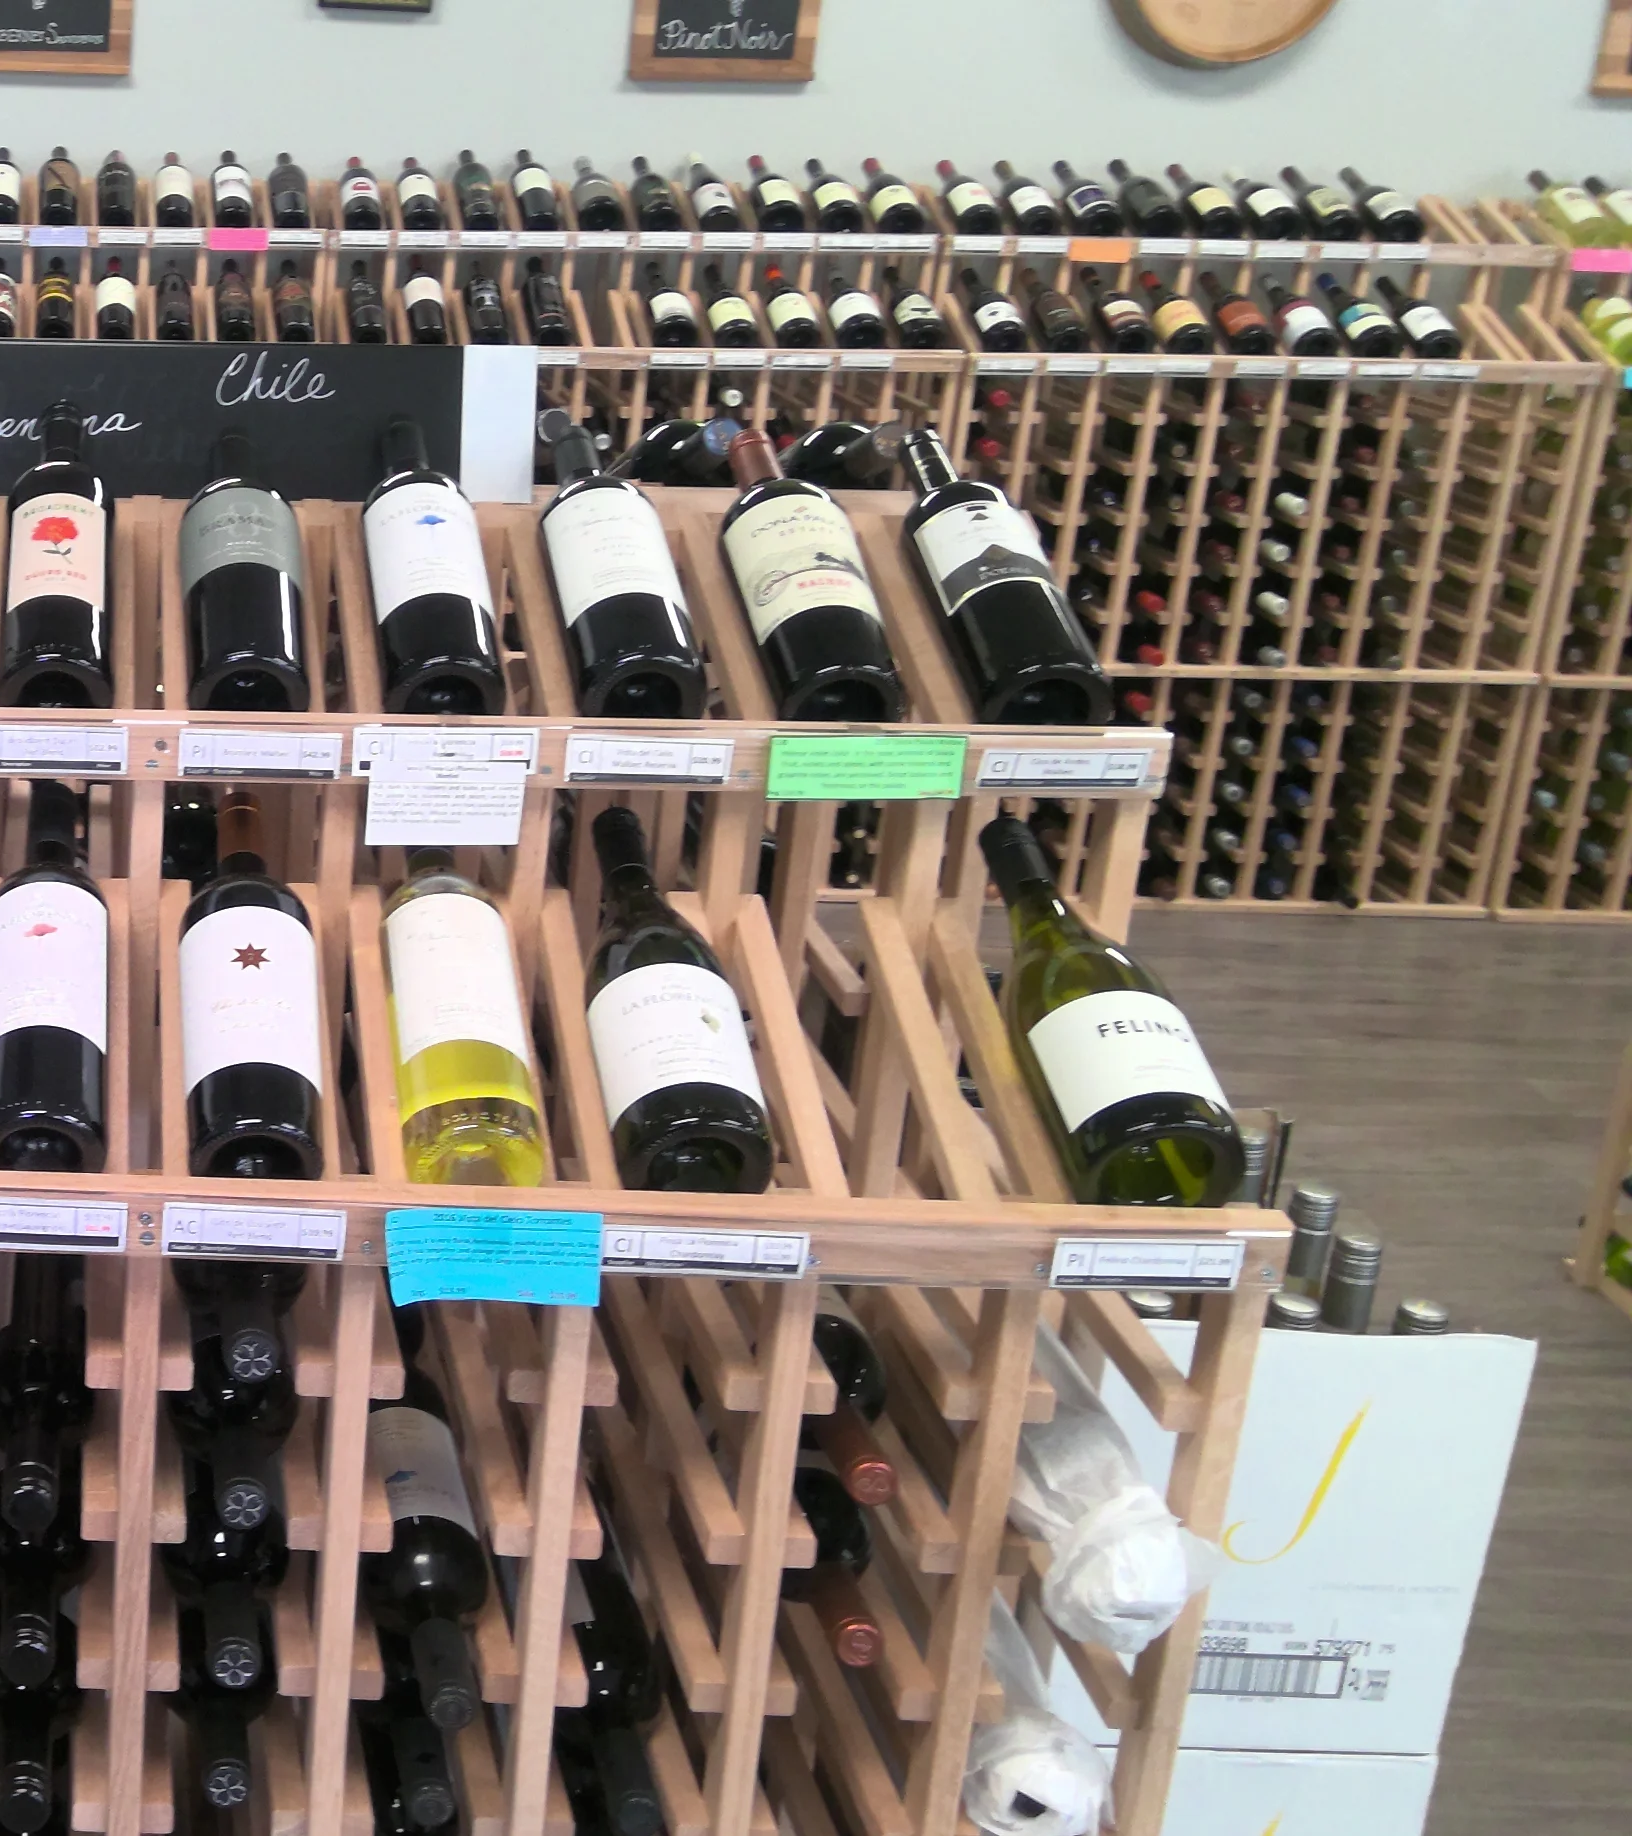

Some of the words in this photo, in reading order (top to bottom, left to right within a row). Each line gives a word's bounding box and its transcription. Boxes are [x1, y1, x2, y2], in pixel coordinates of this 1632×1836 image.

[656, 19, 722, 50] Pinot
[723, 18, 794, 50] Noir
[214, 350, 337, 406] Chile
[173, 1219, 197, 1235] AC
